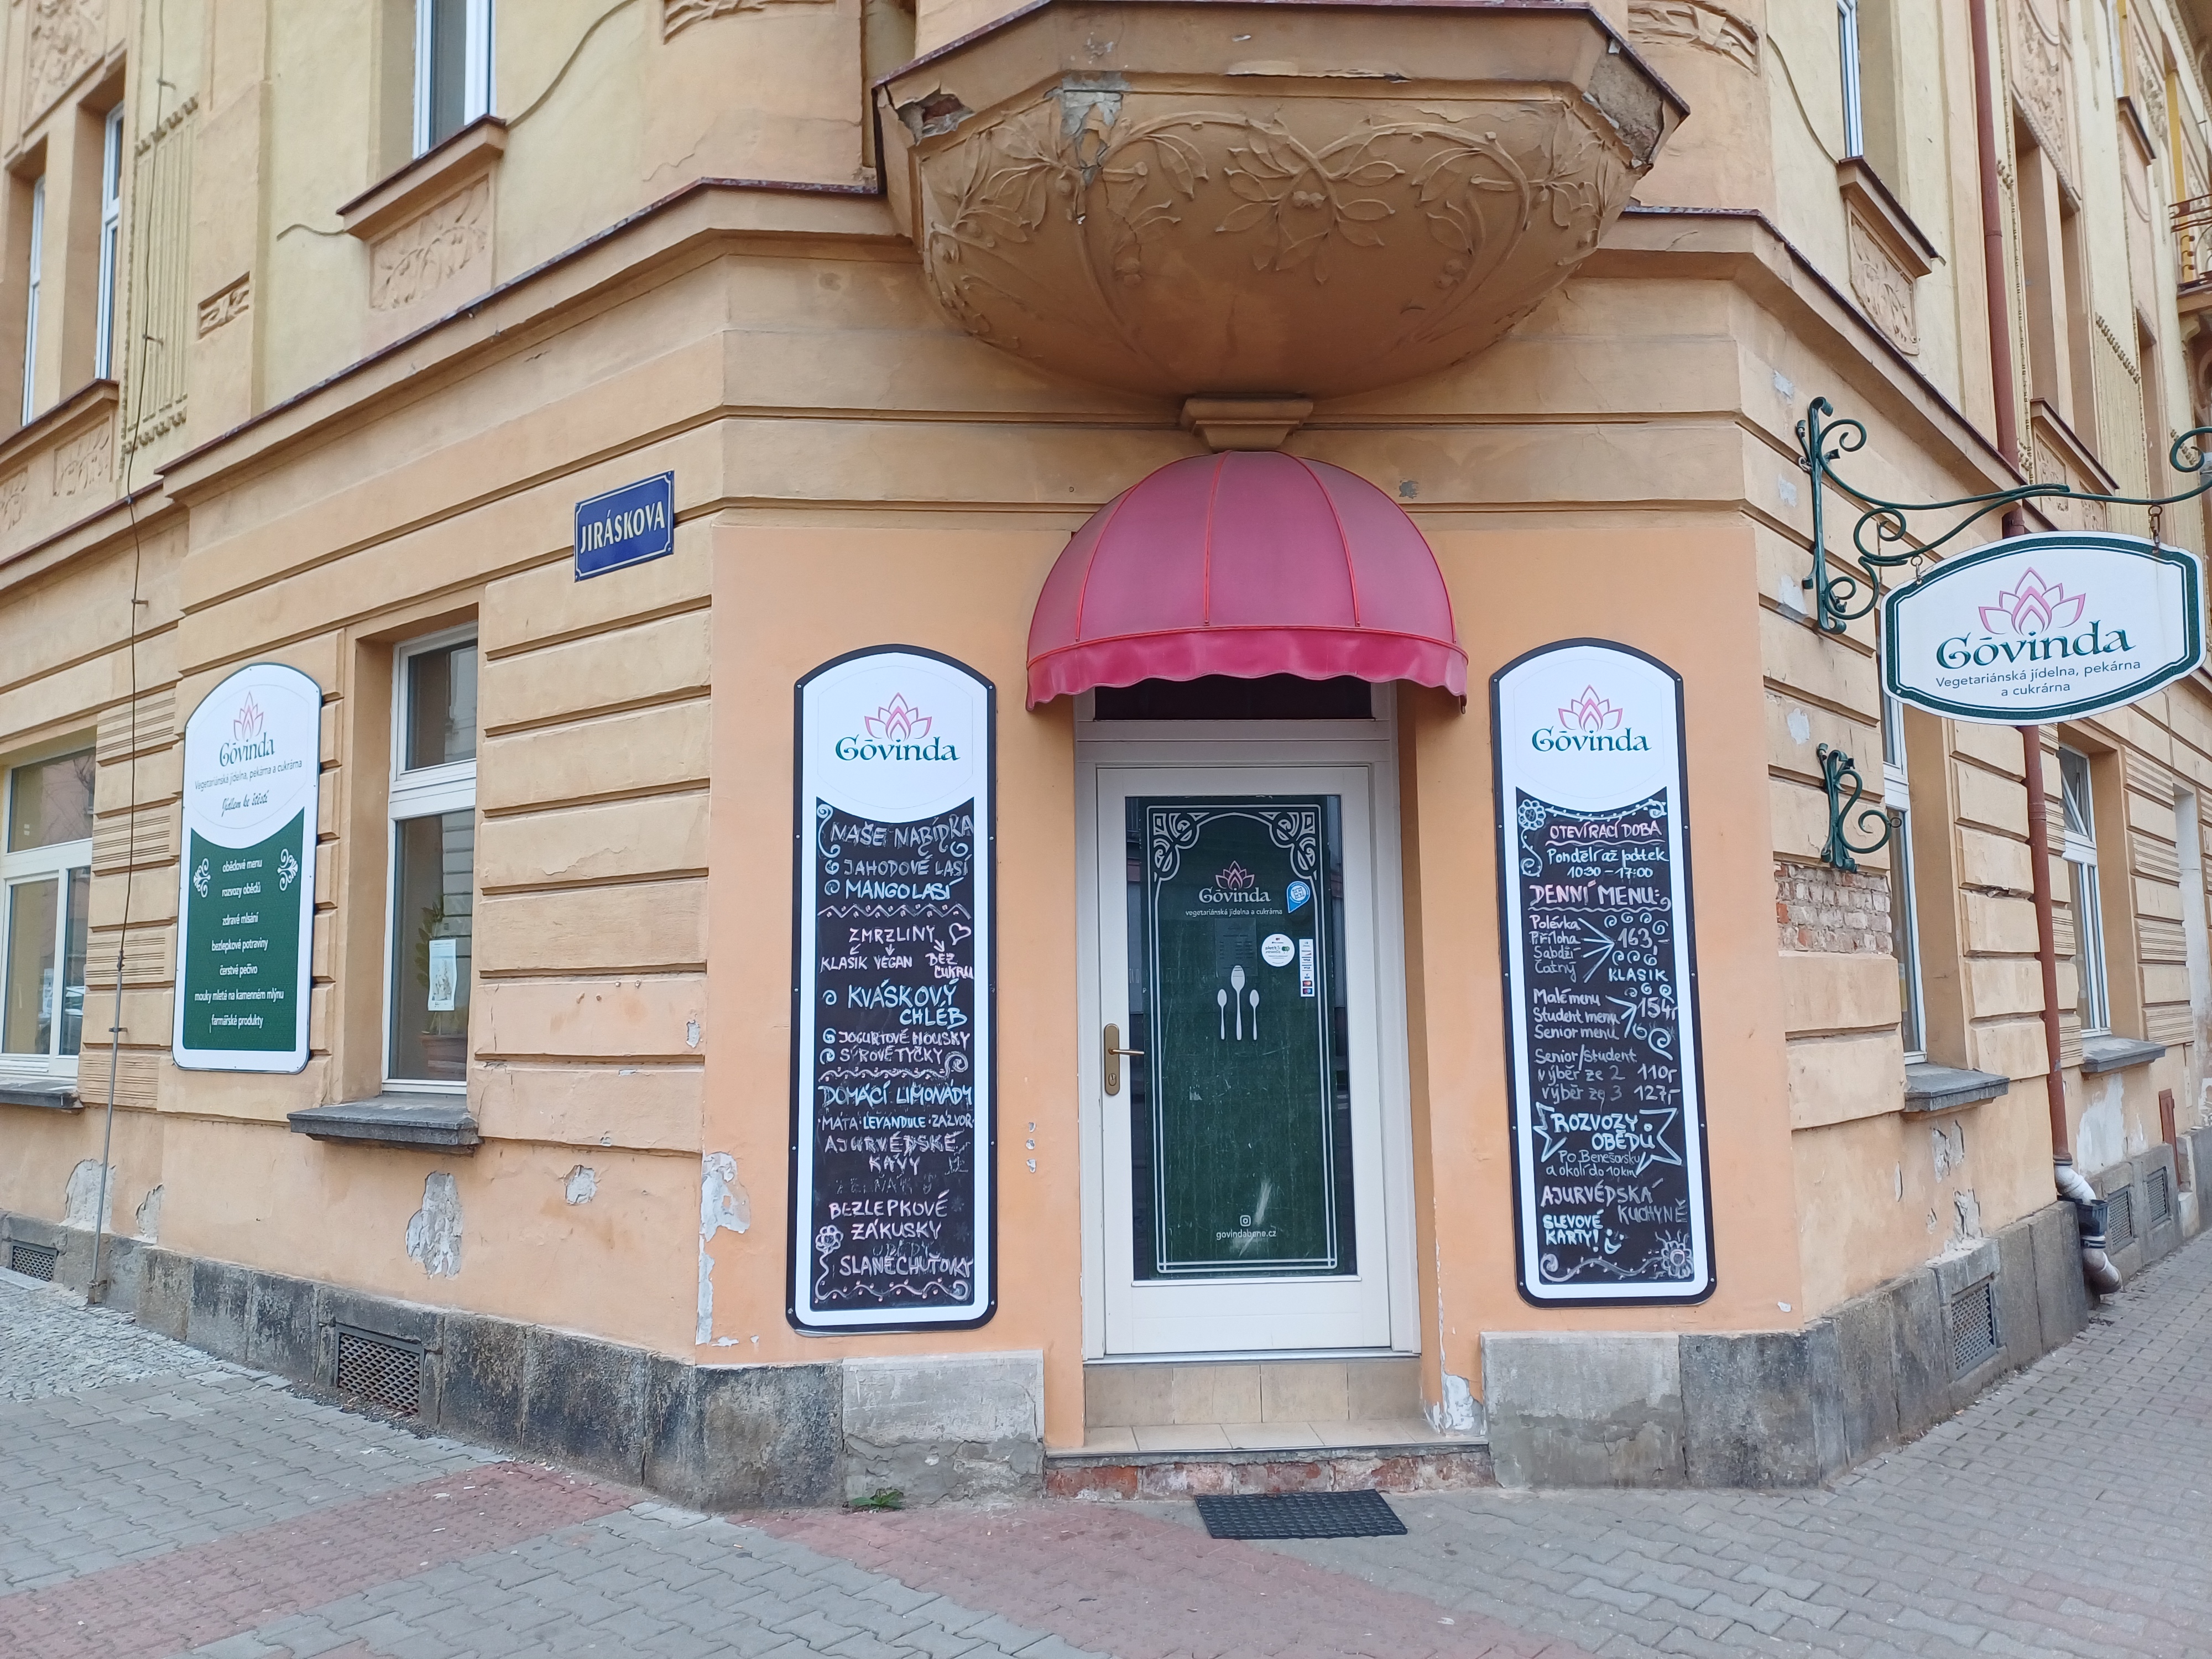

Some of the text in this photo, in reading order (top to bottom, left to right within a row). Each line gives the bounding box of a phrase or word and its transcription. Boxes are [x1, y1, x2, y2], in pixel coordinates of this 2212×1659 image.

[581, 501, 665, 554] JIRÁSKOVA
[1936, 660, 2140, 688] Vegetariánská jídelna, pekárna
[2001, 683, 2070, 696] a cukrárna
[278, 760, 302, 772] cukrárna
[831, 815, 974, 856] NAŠE NABÍDKA
[1550, 817, 1662, 839] OTEVÍRACÍ DOBA
[222, 859, 262, 872] obědové menu
[844, 854, 972, 877] JAHODOVÉ LASÍ
[1547, 847, 1669, 867] Pondělí až pátek
[1567, 867, 1601, 878] 10:30
[222, 881, 261, 898] rozvozy obědů
[1529, 879, 1660, 907] DENNÍ MENU:
[222, 912, 259, 926] zdravé mlsání
[1186, 909, 1228, 917] vegetariánská
[1529, 915, 1581, 930] Polévka
[849, 925, 935, 943] ZMRZLINY
[1529, 931, 1580, 945] Příloha
[211, 937, 268, 954] bezlepkové potraviny
[1533, 946, 1581, 959] Sabdží
[820, 956, 912, 973] KLASIK VEGAN
[925, 953, 957, 966] BEZ
[220, 963, 258, 978] čerstvé pečivo
[935, 966, 974, 979] CUKRU
[1535, 959, 1576, 983] Čatný
[1609, 968, 1669, 982] KLASIK
[195, 989, 211, 1004] mouky
[212, 989, 227, 1000] mleté
[236, 988, 265, 1000] kamenném
[267, 987, 284, 1002] mlýnu
[848, 978, 959, 1009] KVÁSKOVÝ
[1533, 987, 1601, 1006] Malé menu
[211, 1014, 263, 1029] farmářské produkty
[899, 1000, 968, 1030] CHLÉB
[1533, 1006, 1621, 1024] Student menu
[838, 1029, 971, 1051] JOGURTOVÉ HOUSKY
[1534, 1024, 1619, 1040] Senior menu
[840, 1045, 942, 1065] SÝROVÉ TYČKY
[1538, 1064, 1580, 1086] výběr
[1585, 1070, 1604, 1082] ze
[1609, 1065, 1625, 1080] 2
[818, 1079, 972, 1107] DOMÁCÍ LIMONÁDY
[1542, 1083, 1584, 1104] výběr
[1610, 1085, 1623, 1101] 3
[1551, 1113, 1638, 1133] ROZVOZY
[825, 1129, 964, 1156] AJURVÉDSKÉ
[869, 1154, 920, 1175] KÁVY
[1558, 1150, 1641, 1165] Po Benešovsku
[1546, 1165, 1557, 1176] a
[1559, 1162, 1590, 1177] okolí
[1589, 1164, 1604, 1176] do
[1541, 1178, 1663, 1207] AJURVÉDSKÁ
[829, 1190, 950, 1219] BEZLEPKOVÉ
[1618, 1198, 1687, 1224] KUCHYNĚ
[1542, 1209, 1604, 1229] SLEVOVÉ
[851, 1218, 941, 1240] ZÁKUSKY
[1546, 1229, 1599, 1252] KARTY!
